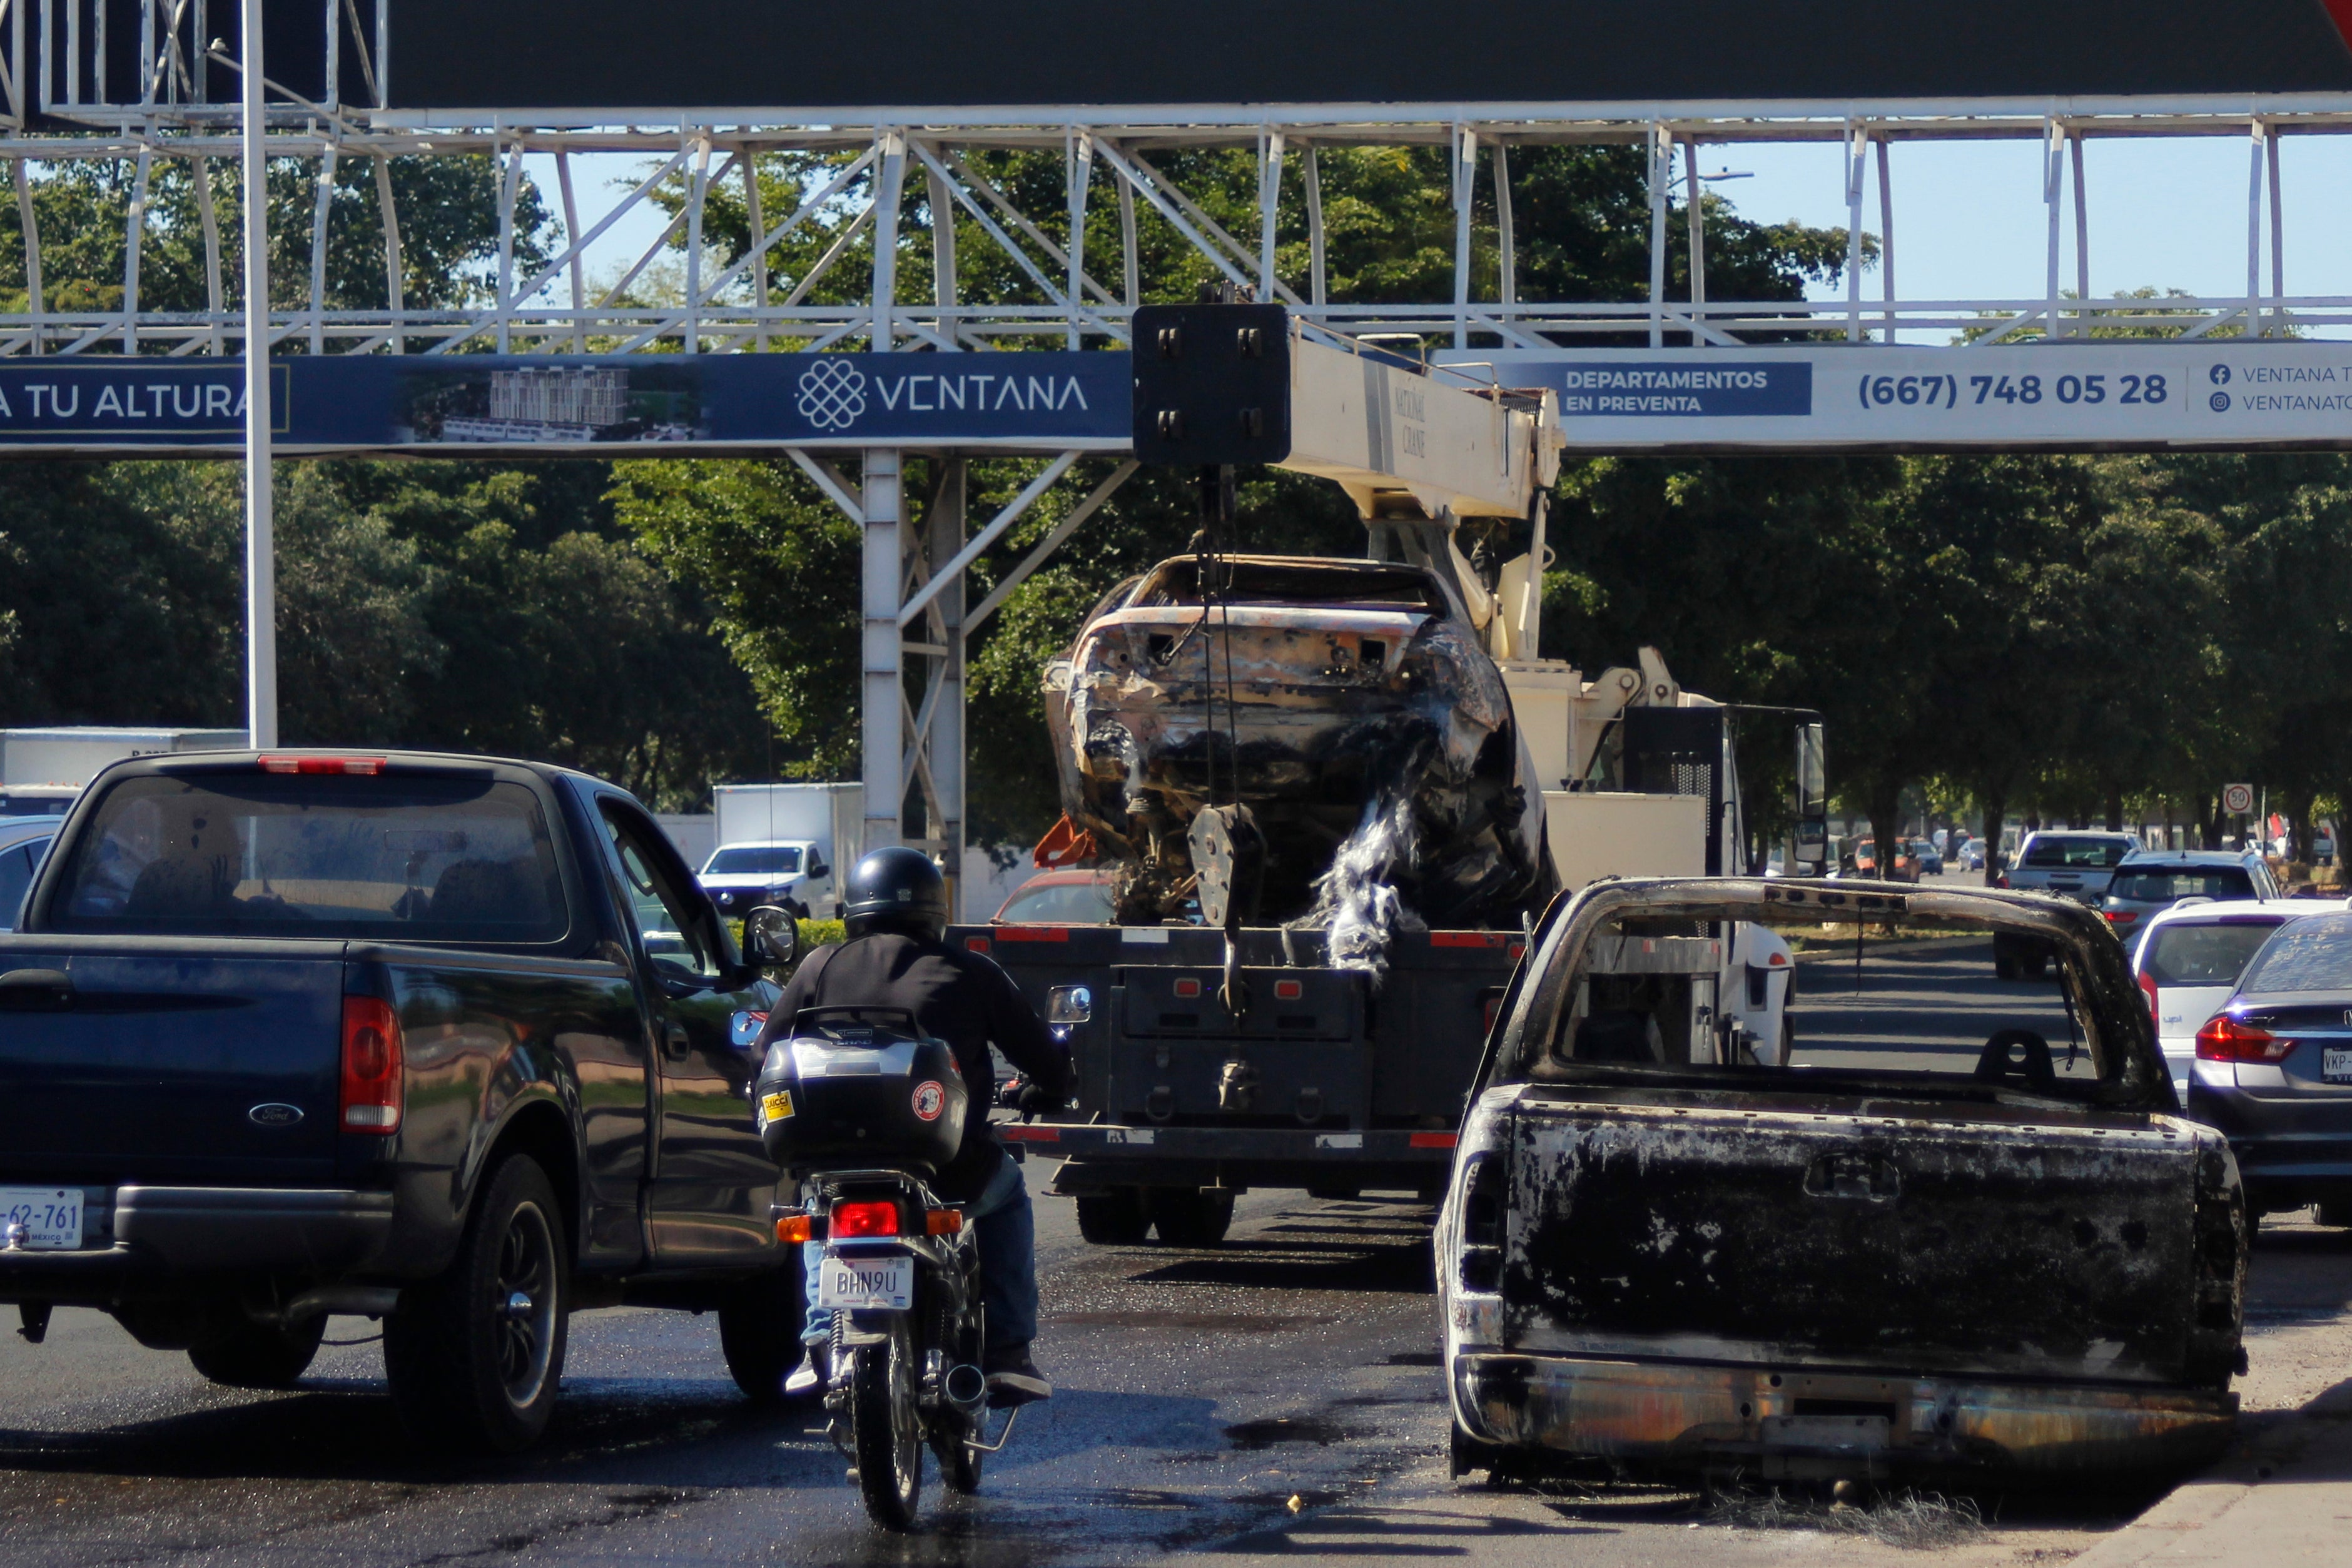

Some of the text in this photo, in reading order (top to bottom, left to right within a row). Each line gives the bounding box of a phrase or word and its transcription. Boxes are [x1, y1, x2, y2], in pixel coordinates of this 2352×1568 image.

[1566, 371, 1767, 388] DEPARTAMENTOS
[2243, 367, 2336, 382] VENTANA
[875, 375, 1088, 410] VENTANA
[1859, 375, 2167, 409] (667) 748 05 28
[25, 385, 79, 417] TU
[1566, 397, 1701, 412] EN PREVENTA
[2232, 791, 2245, 802] 50
[262, 1108, 290, 1120] Ford
